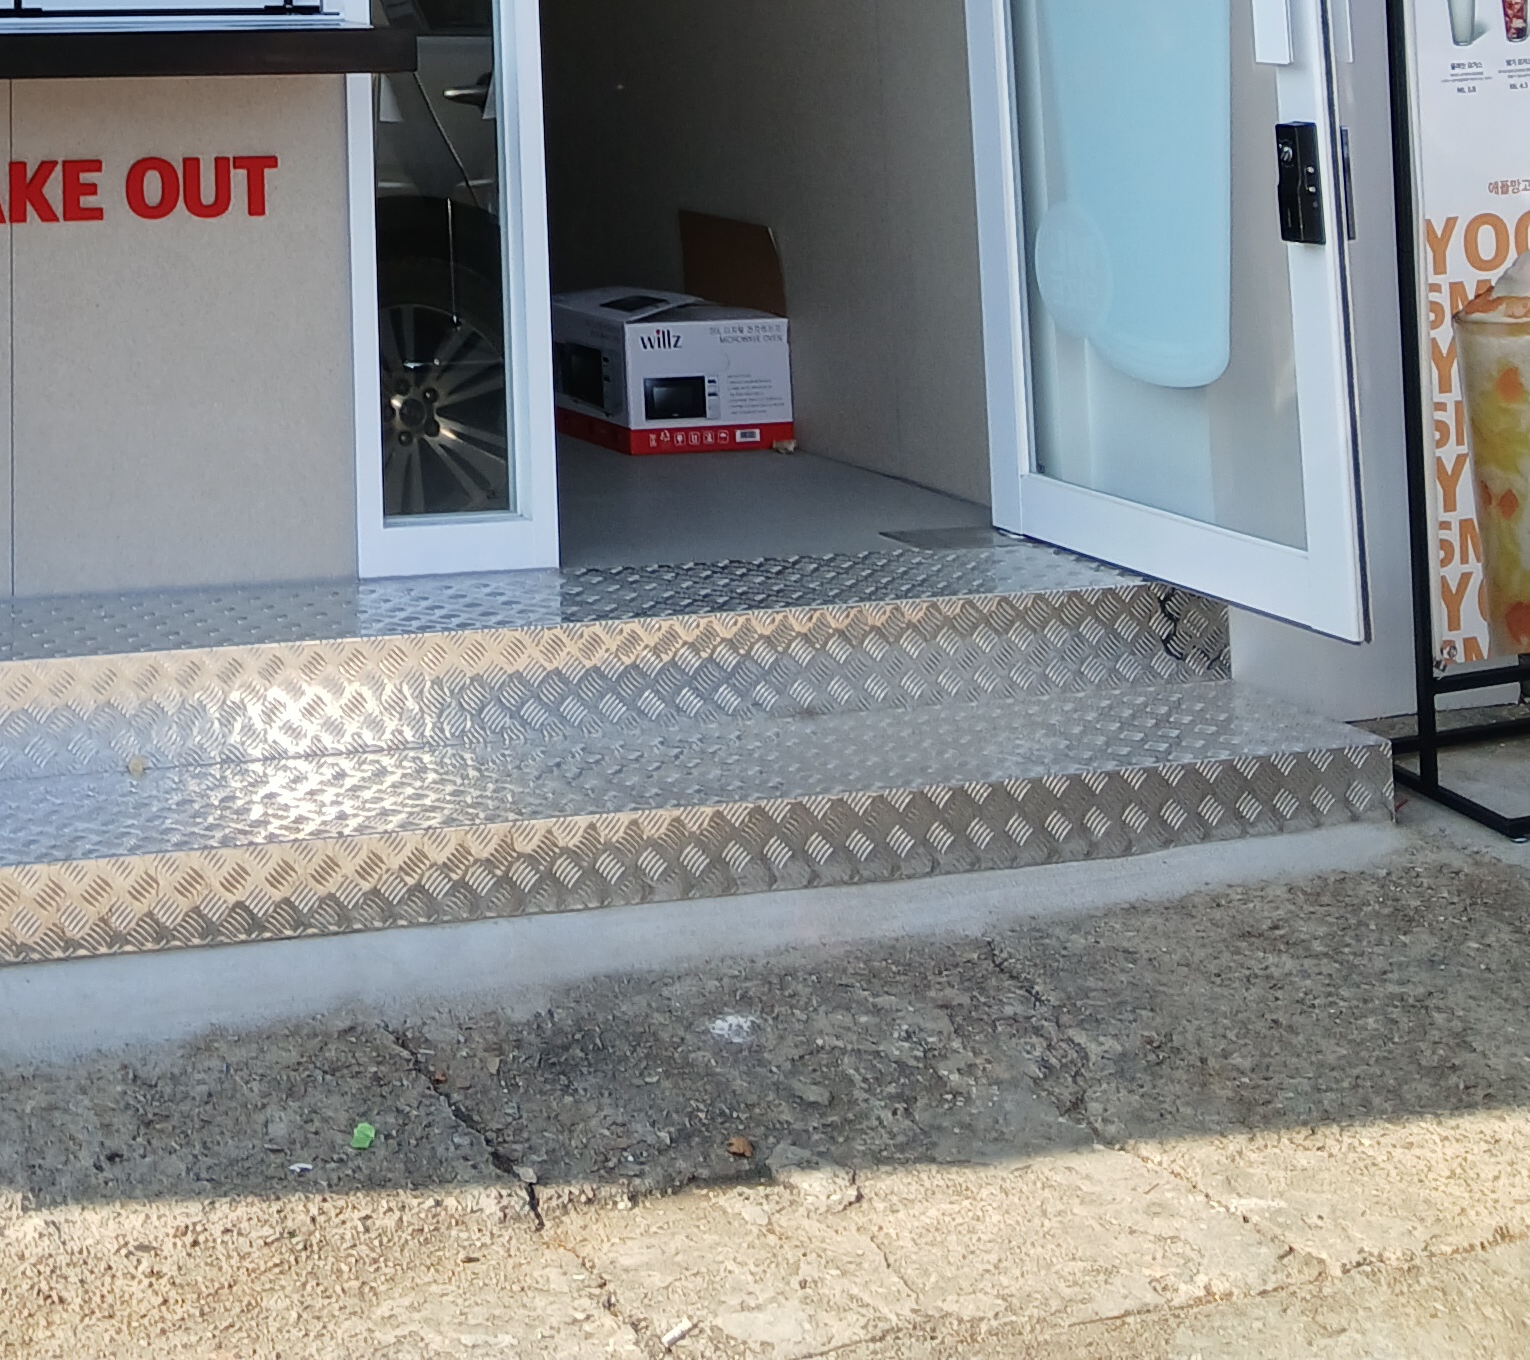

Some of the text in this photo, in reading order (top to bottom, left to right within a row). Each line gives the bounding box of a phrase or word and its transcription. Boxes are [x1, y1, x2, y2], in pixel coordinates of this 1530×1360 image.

[125, 155, 278, 220] OUT
[1424, 210, 1530, 276] YO
[640, 329, 682, 349] willz
